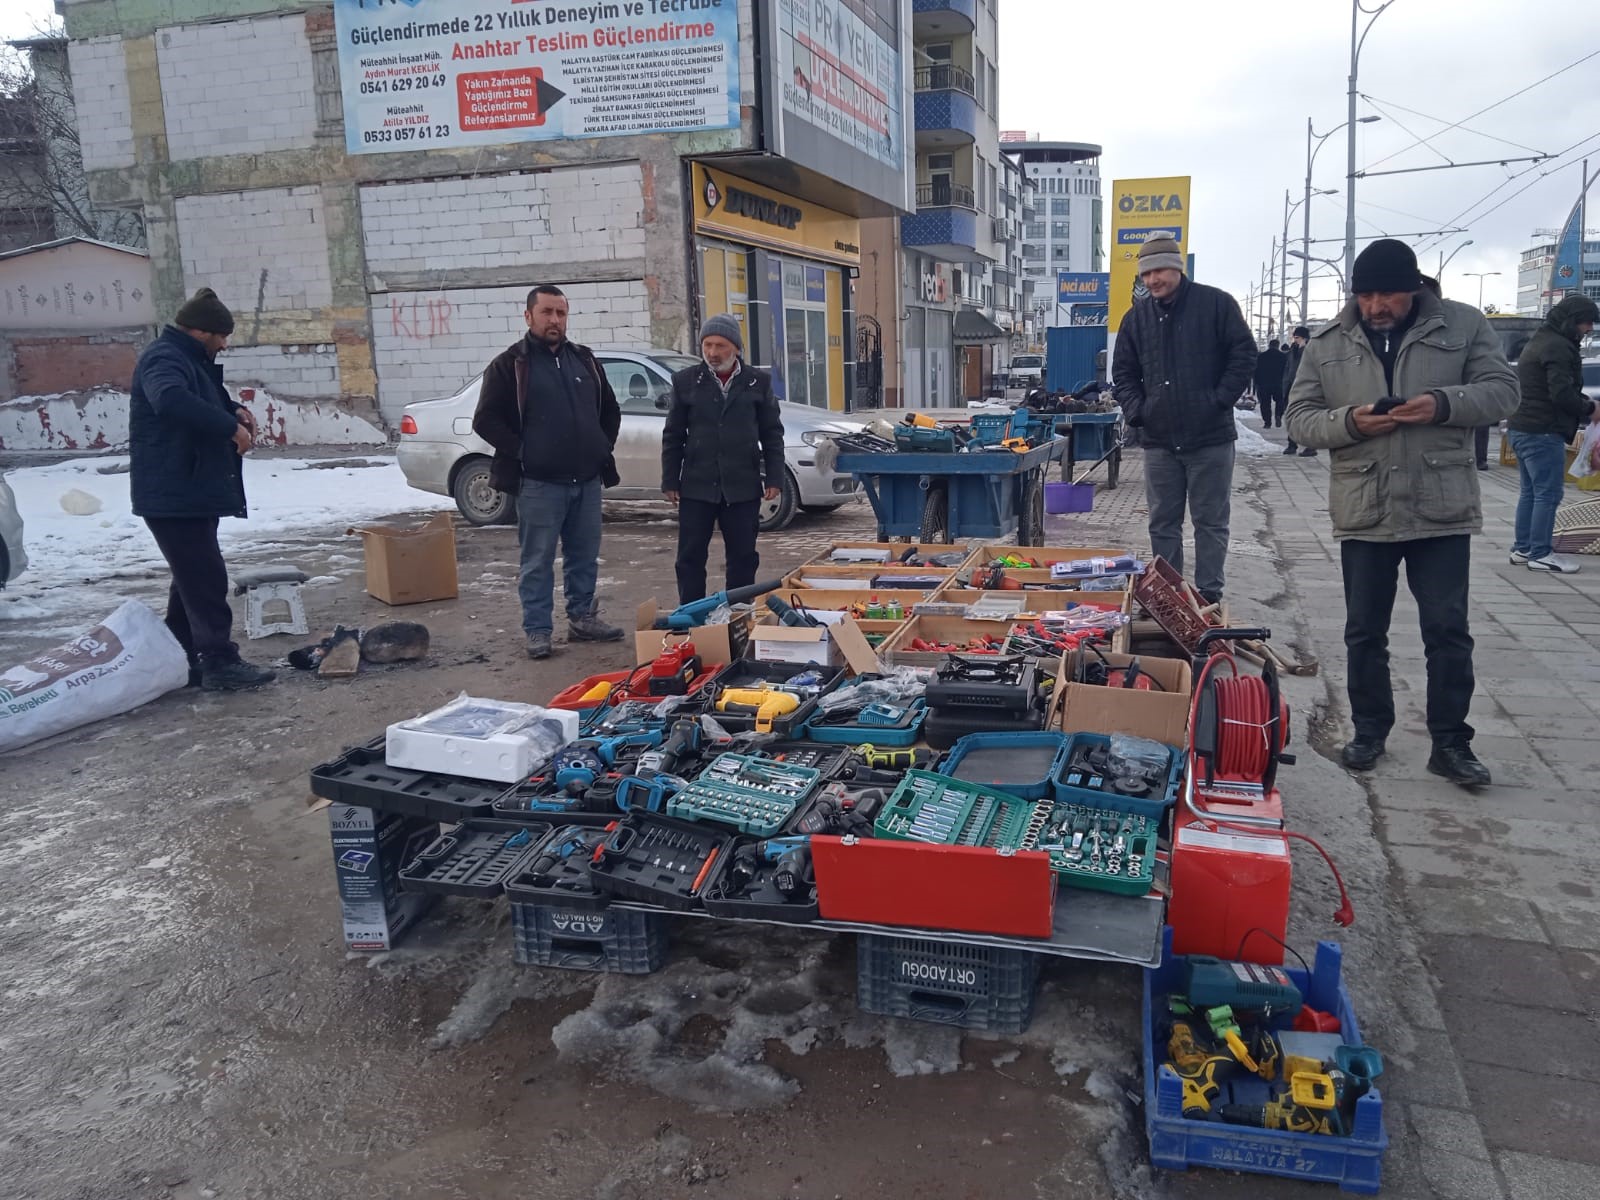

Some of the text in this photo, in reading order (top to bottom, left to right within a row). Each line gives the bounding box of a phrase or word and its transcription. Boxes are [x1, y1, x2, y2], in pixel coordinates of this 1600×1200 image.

[351, 17, 469, 45] Güçlendirmede
[474, 14, 493, 32] 22
[497, 9, 542, 29] Yıllık
[545, 2, 619, 24] Deneyim
[624, 2, 644, 16] ve
[452, 22, 715, 60] Anahtar Teslim Güçlendirme
[360, 51, 443, 68] Müteahhit İnşaat Müh.
[561, 57, 591, 65] MALATYA
[621, 52, 635, 60] CAM
[671, 43, 723, 55] GÜÇLENDİRMESİ
[365, 61, 440, 80] Aydın Murat KEKLİK
[562, 66, 592, 75] MALATYA
[635, 60, 670, 69] KARAKOLU
[671, 53, 723, 66] GÜÇLENDİRMESİ
[639, 69, 660, 79] SİTESİ
[661, 65, 713, 77] GÜÇLENDİRMESİ
[360, 74, 446, 94] 0541 629 20 49
[464, 74, 532, 89] Yakın Zamanda
[581, 84, 598, 93] MİLLİ
[654, 76, 705, 88] GÜÇLENDİRMESİ
[465, 88, 532, 102] Yaptığımız Bazı
[632, 90, 666, 99] FABRİKASI
[667, 85, 719, 97] GÜÇLENDİRMESİ
[386, 104, 424, 115] Müteahhit
[644, 98, 696, 109] GÜÇLENDİRMESİ
[383, 118, 403, 127] Atilla
[464, 112, 536, 126] Referanslarımız
[584, 114, 600, 123] TÜRK
[601, 113, 630, 122] TELEKOM
[654, 107, 705, 119] GÜÇLENDİRMESİ
[583, 125, 609, 133] ANKARA
[654, 117, 706, 128] GÜÇLENDİRMESİ
[364, 125, 450, 143] 0533 057 61 23
[723, 186, 802, 230] DUNLOP
[1118, 193, 1183, 213] ÖZKA
[1079, 278, 1098, 292] AKÜ
[65, 671, 97, 690] Arpa
[553, 919, 603, 933] ADA
[1295, 1159, 1316, 1172] 27
